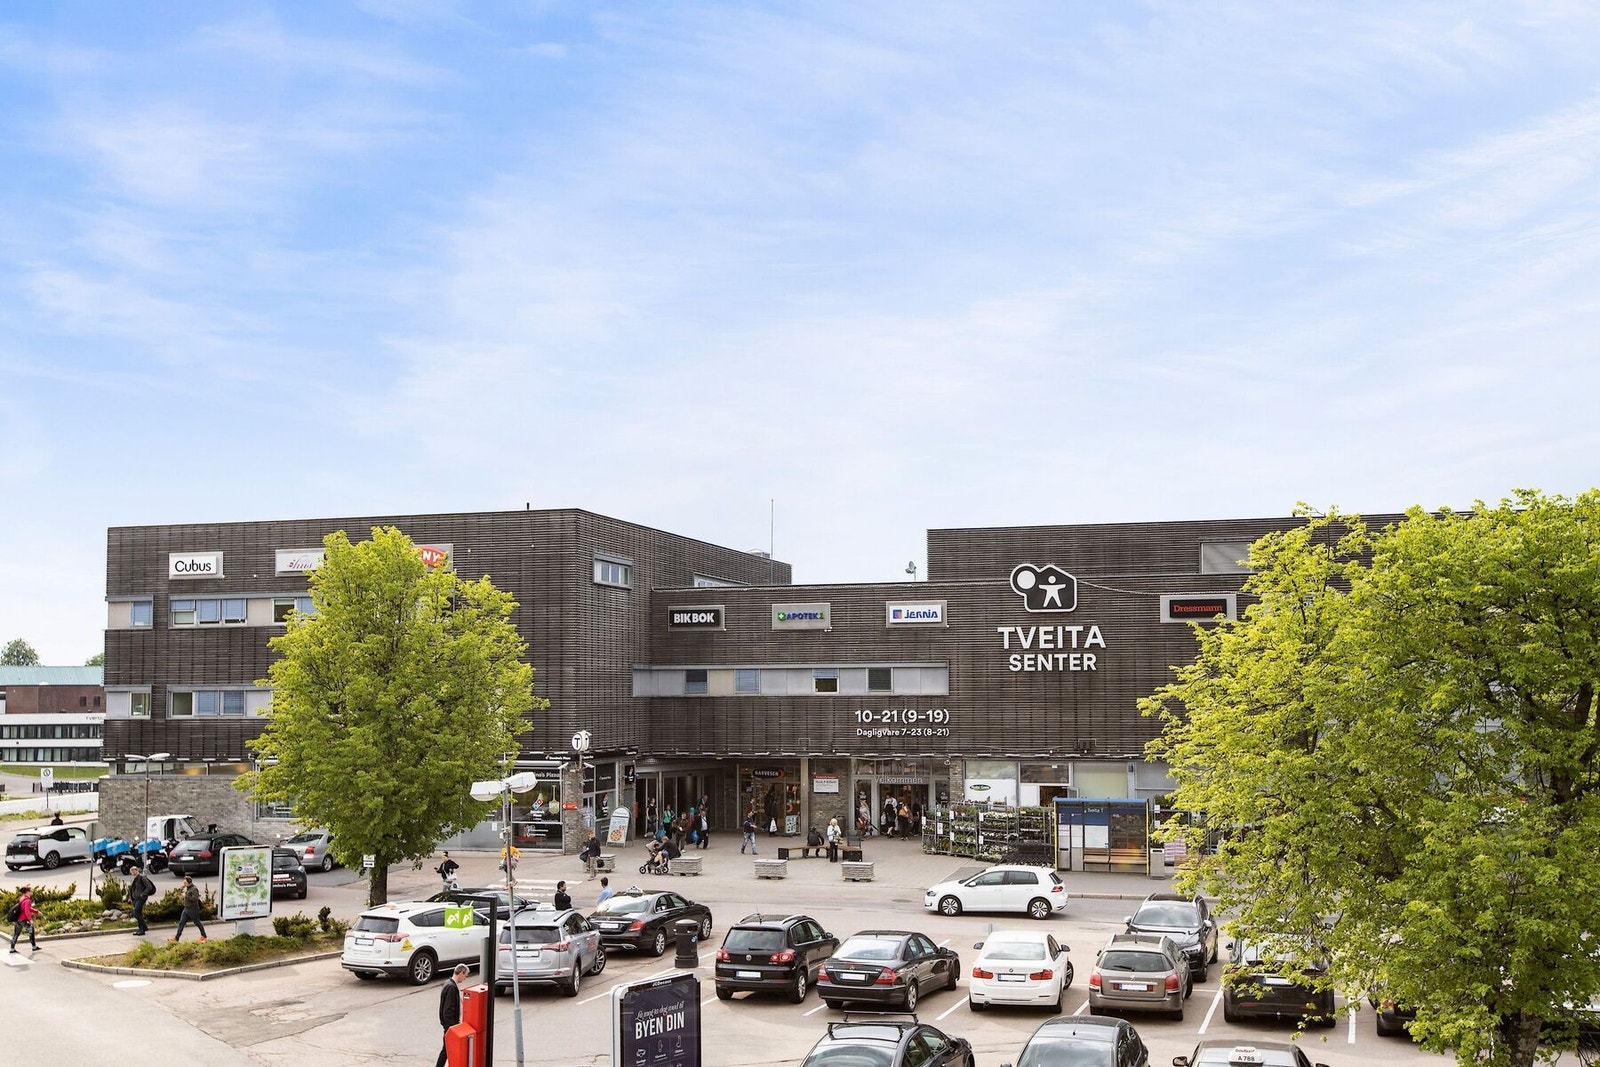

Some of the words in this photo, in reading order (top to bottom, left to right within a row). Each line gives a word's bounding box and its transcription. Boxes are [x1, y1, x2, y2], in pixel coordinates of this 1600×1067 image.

[422, 550, 441, 562] NY
[175, 559, 212, 573] Cubus
[1173, 604, 1223, 613] Dressmann
[673, 612, 691, 624] BIK
[692, 612, 715, 623] BOK
[786, 612, 819, 620] APOTEK
[819, 612, 824, 620] 1
[997, 626, 1106, 649] TVEITA
[1009, 653, 1097, 672] SENTER
[855, 710, 898, 723] 10-21
[902, 708, 950, 725] (9-19)
[856, 728, 900, 738] Dagligvare
[901, 728, 922, 736] 7-23
[923, 728, 950, 737] (8-21)
[874, 774, 923, 783] Velkommen
[635, 1016, 663, 1039] BYEN
[666, 1011, 685, 1032] DIN
